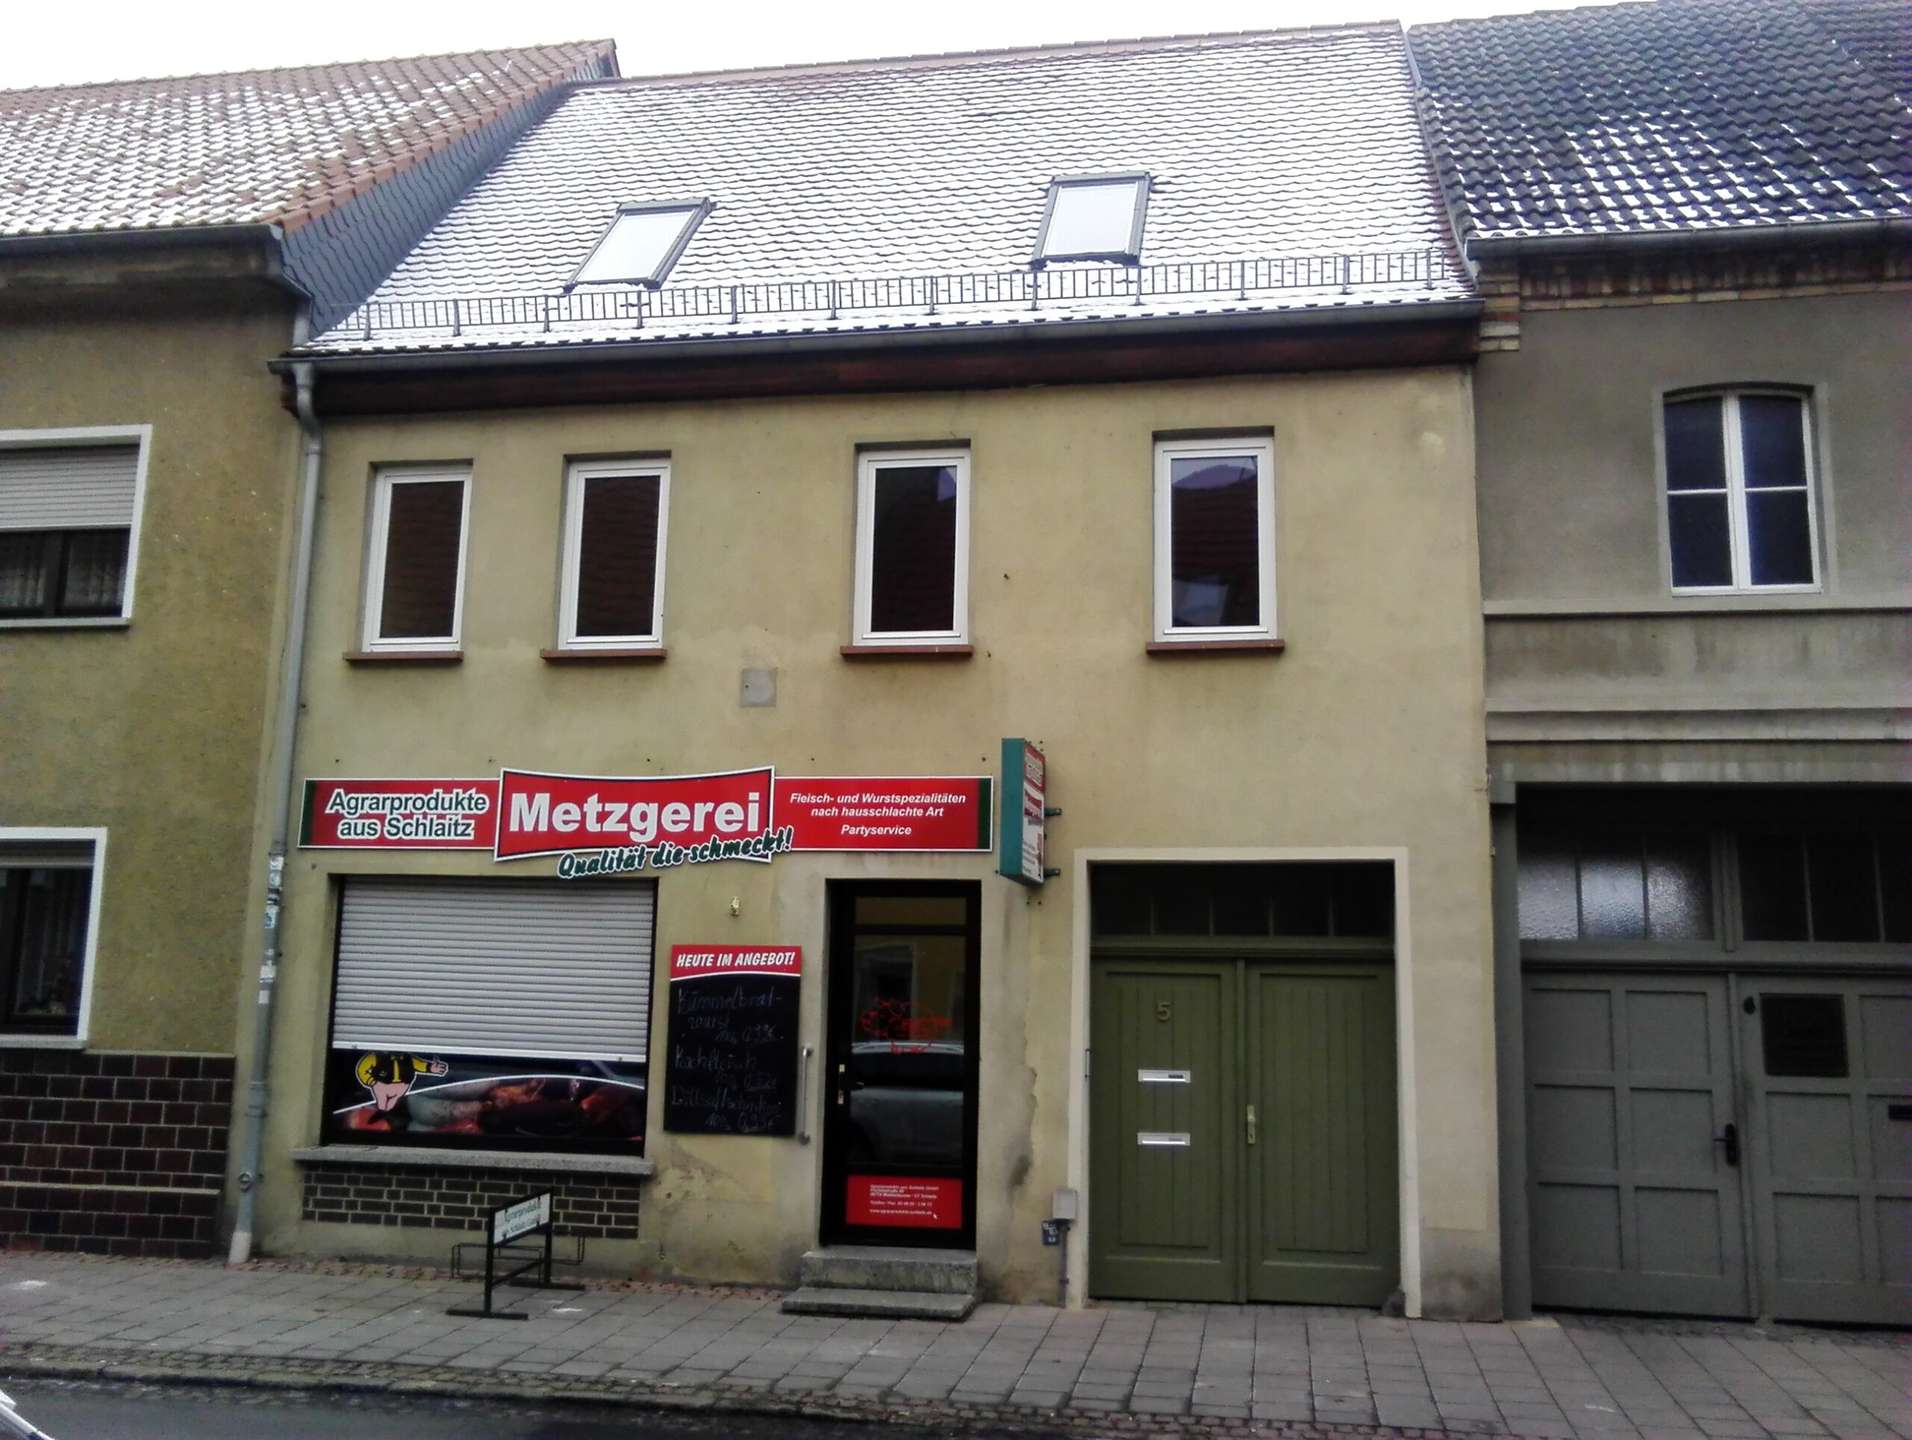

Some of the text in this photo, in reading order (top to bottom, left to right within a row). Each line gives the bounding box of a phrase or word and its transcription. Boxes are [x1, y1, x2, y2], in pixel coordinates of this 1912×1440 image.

[327, 788, 489, 815] Agrarprodukte
[790, 793, 966, 806] Fleisch- und Wurstspezialitäten
[509, 792, 760, 843] Metzgerei
[811, 806, 944, 817] nach hausschlachte Art
[338, 815, 475, 840] aus Schlaitz
[841, 824, 912, 837] Partyservice
[558, 827, 794, 878] Qualität die schmeckt!
[676, 952, 796, 967] HEUTE IM ANGEBOT!
[1157, 1001, 1171, 1022] 5
